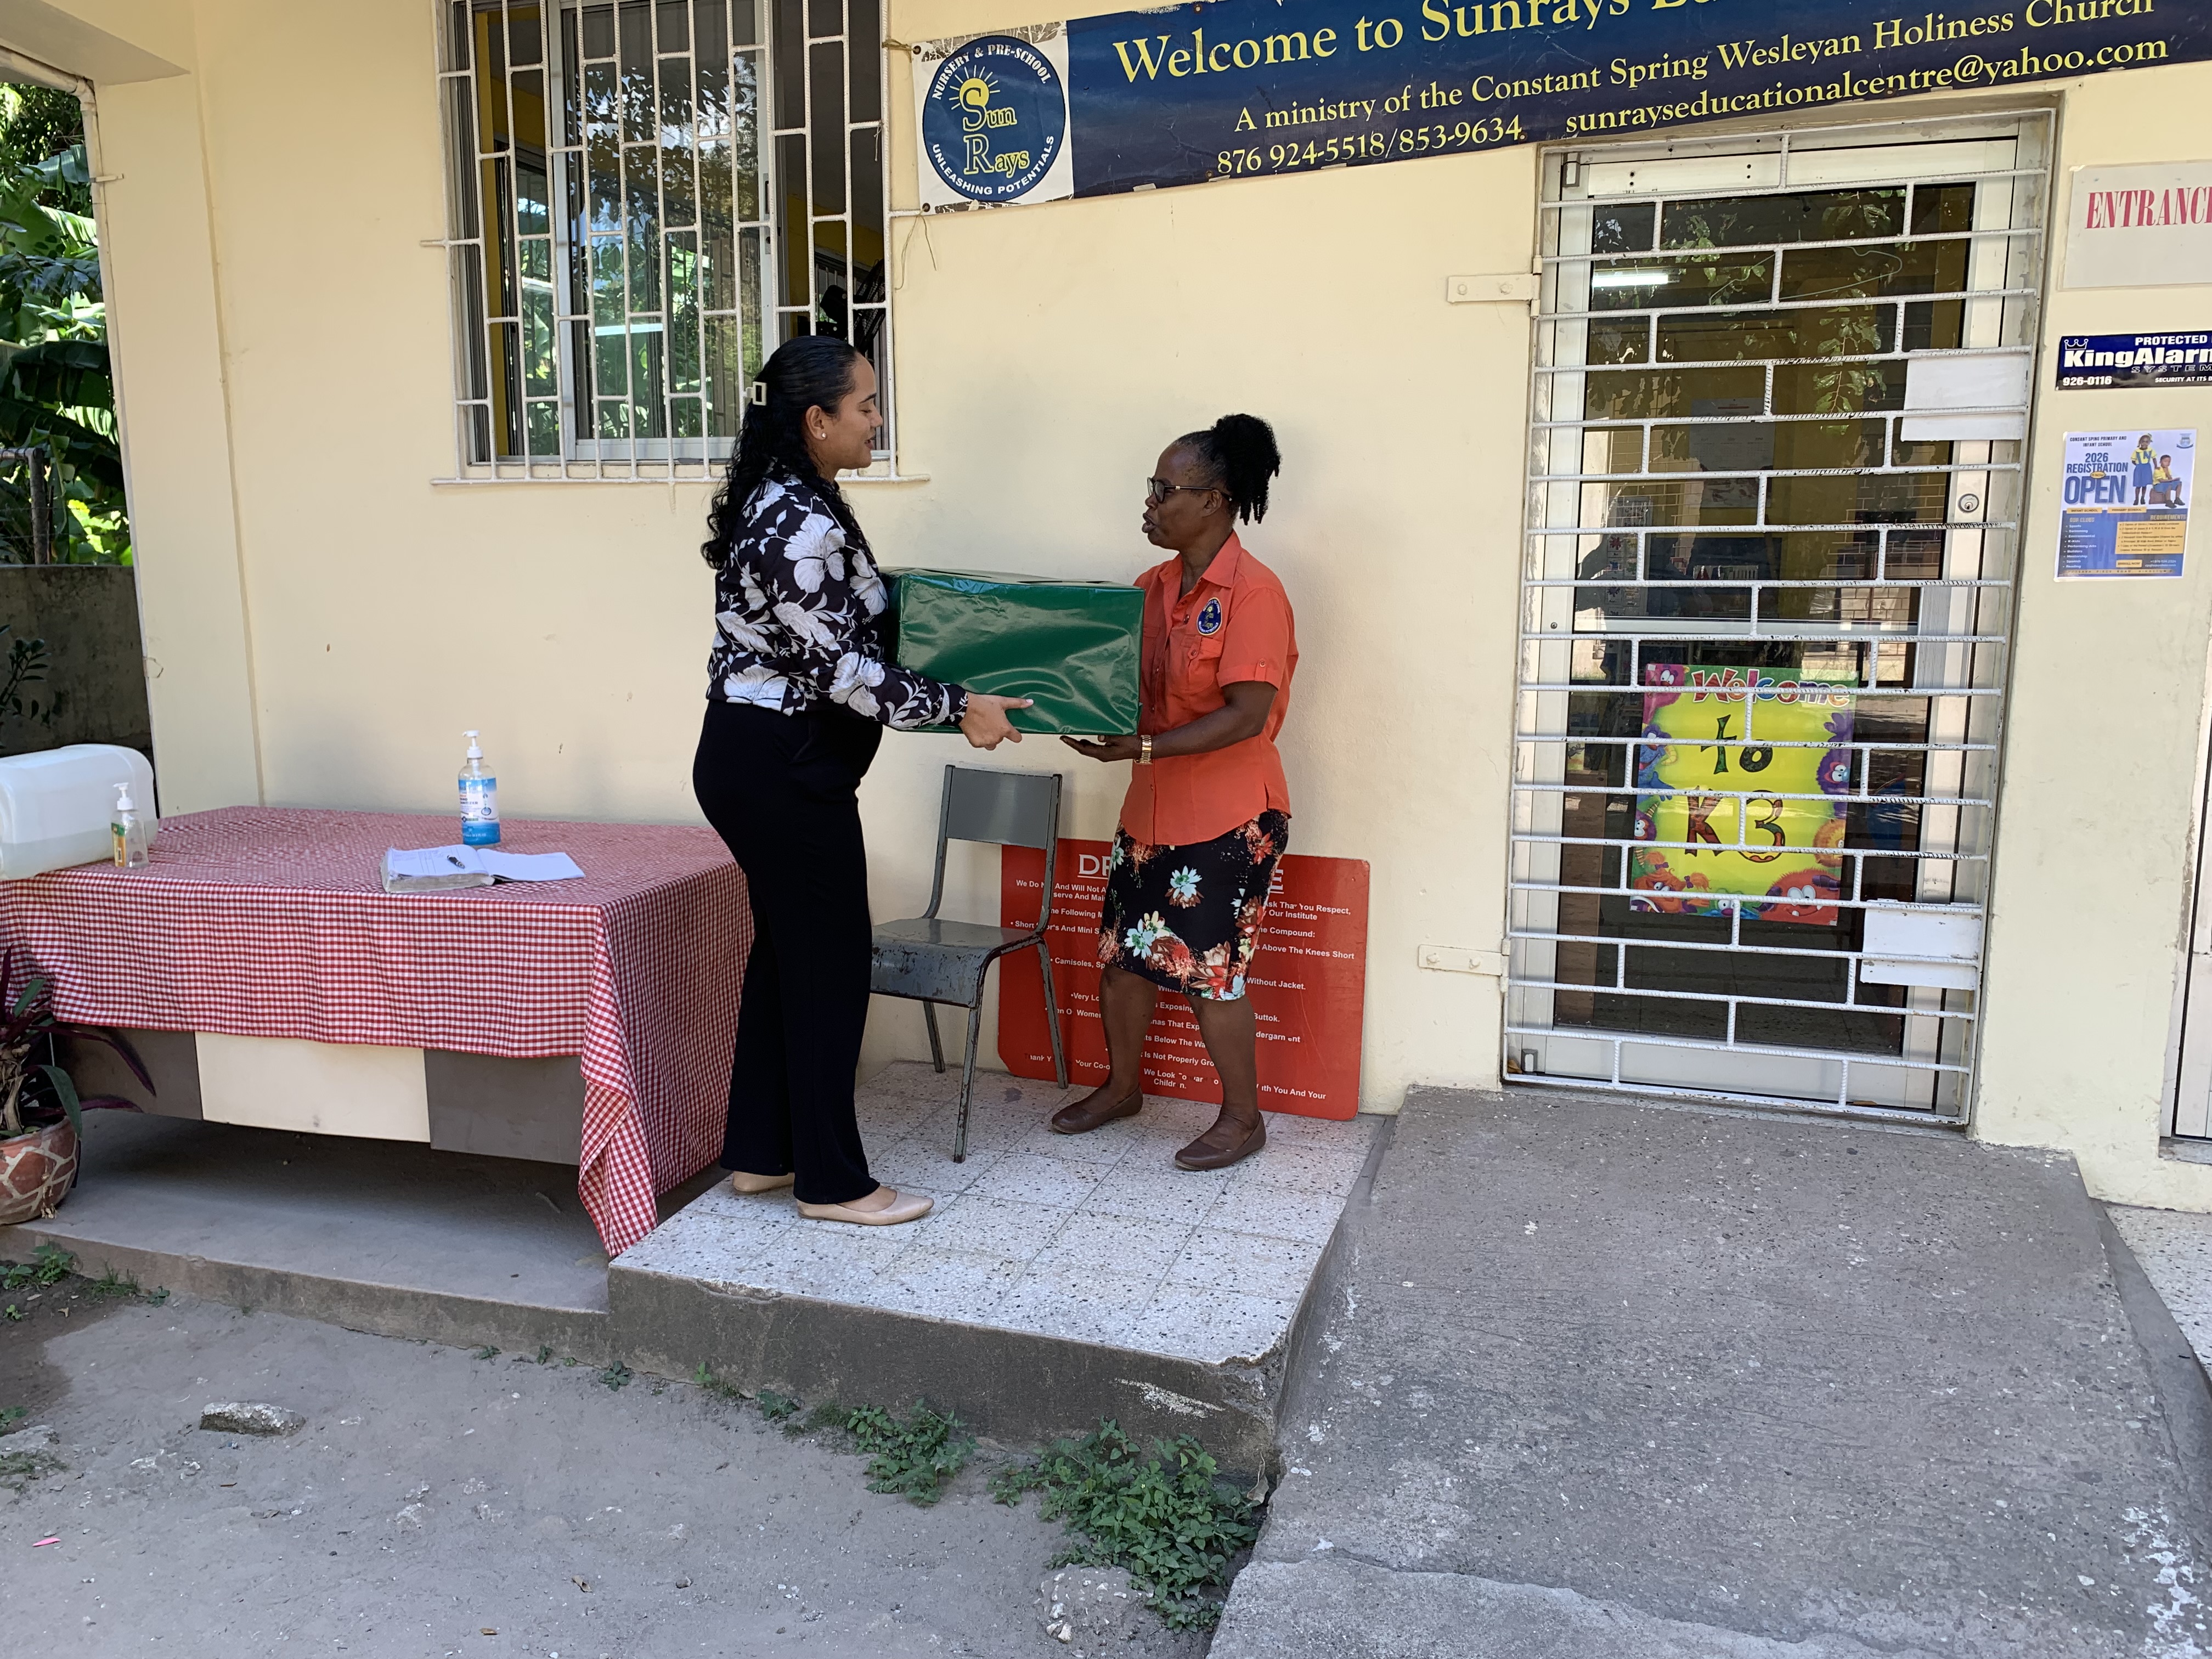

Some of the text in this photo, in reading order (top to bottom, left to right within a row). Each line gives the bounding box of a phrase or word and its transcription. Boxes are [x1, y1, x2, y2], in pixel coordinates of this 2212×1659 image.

[1113, 27, 1336, 83] Welcome
[1355, 16, 1403, 51] to
[932, 44, 1052, 100] NURSERY & PRE-SCHOOL
[1234, 106, 1257, 132] A
[1265, 98, 1376, 129] ministry
[1384, 85, 1412, 113] of
[1419, 81, 1463, 109] the
[1471, 67, 1601, 102] Constant
[1610, 53, 1708, 88] Spring
[1716, 34, 1862, 70] Wesleyan
[1873, 12, 2014, 50] Holiness
[1566, 39, 2168, 133] sunrayseducationalcentre@yahoo.com
[960, 87, 1017, 131] Sun
[963, 134, 1030, 178] Rays
[1217, 114, 1522, 174] 876 924-5518/853-9634
[933, 136, 1054, 195] UNLEASHING POTENTIALS
[2135, 335, 2208, 346] PROTECTED
[2063, 376, 2112, 386] 926-0116
[2067, 462, 2128, 473] REGISTRATION
[2085, 453, 2108, 462] 2026
[2064, 475, 2126, 504] OPEN
[1691, 668, 1850, 708] Welcome
[1061, 908, 1096, 918] Following
[1269, 927, 1315, 938] Compound:
[1285, 911, 1318, 921] Institute
[1299, 903, 1314, 911] You
[1316, 905, 1351, 915] Respect,
[1015, 921, 1035, 929] Short
[1262, 944, 1286, 952] Above
[1289, 946, 1304, 954] The
[1305, 948, 1330, 957] Knees
[1332, 951, 1355, 960] Short
[1054, 957, 1094, 968] Camisoles,
[1246, 977, 1277, 986] Without
[1278, 980, 1306, 990] Jacket.
[1074, 992, 1089, 1002] Very
[1160, 1002, 1194, 1013] Exposing
[1168, 1020, 1183, 1029] That
[1154, 1035, 1177, 1045] Below
[1178, 1038, 1193, 1046] The
[1153, 1052, 1166, 1060] Not
[1167, 1055, 1199, 1066] Properly
[1154, 1079, 1187, 1089] Childrn.
[1157, 1070, 1175, 1079] Look
[1273, 1086, 1288, 1094] You
[1290, 1088, 1306, 1097] And
[1308, 1091, 1327, 1099] Your
